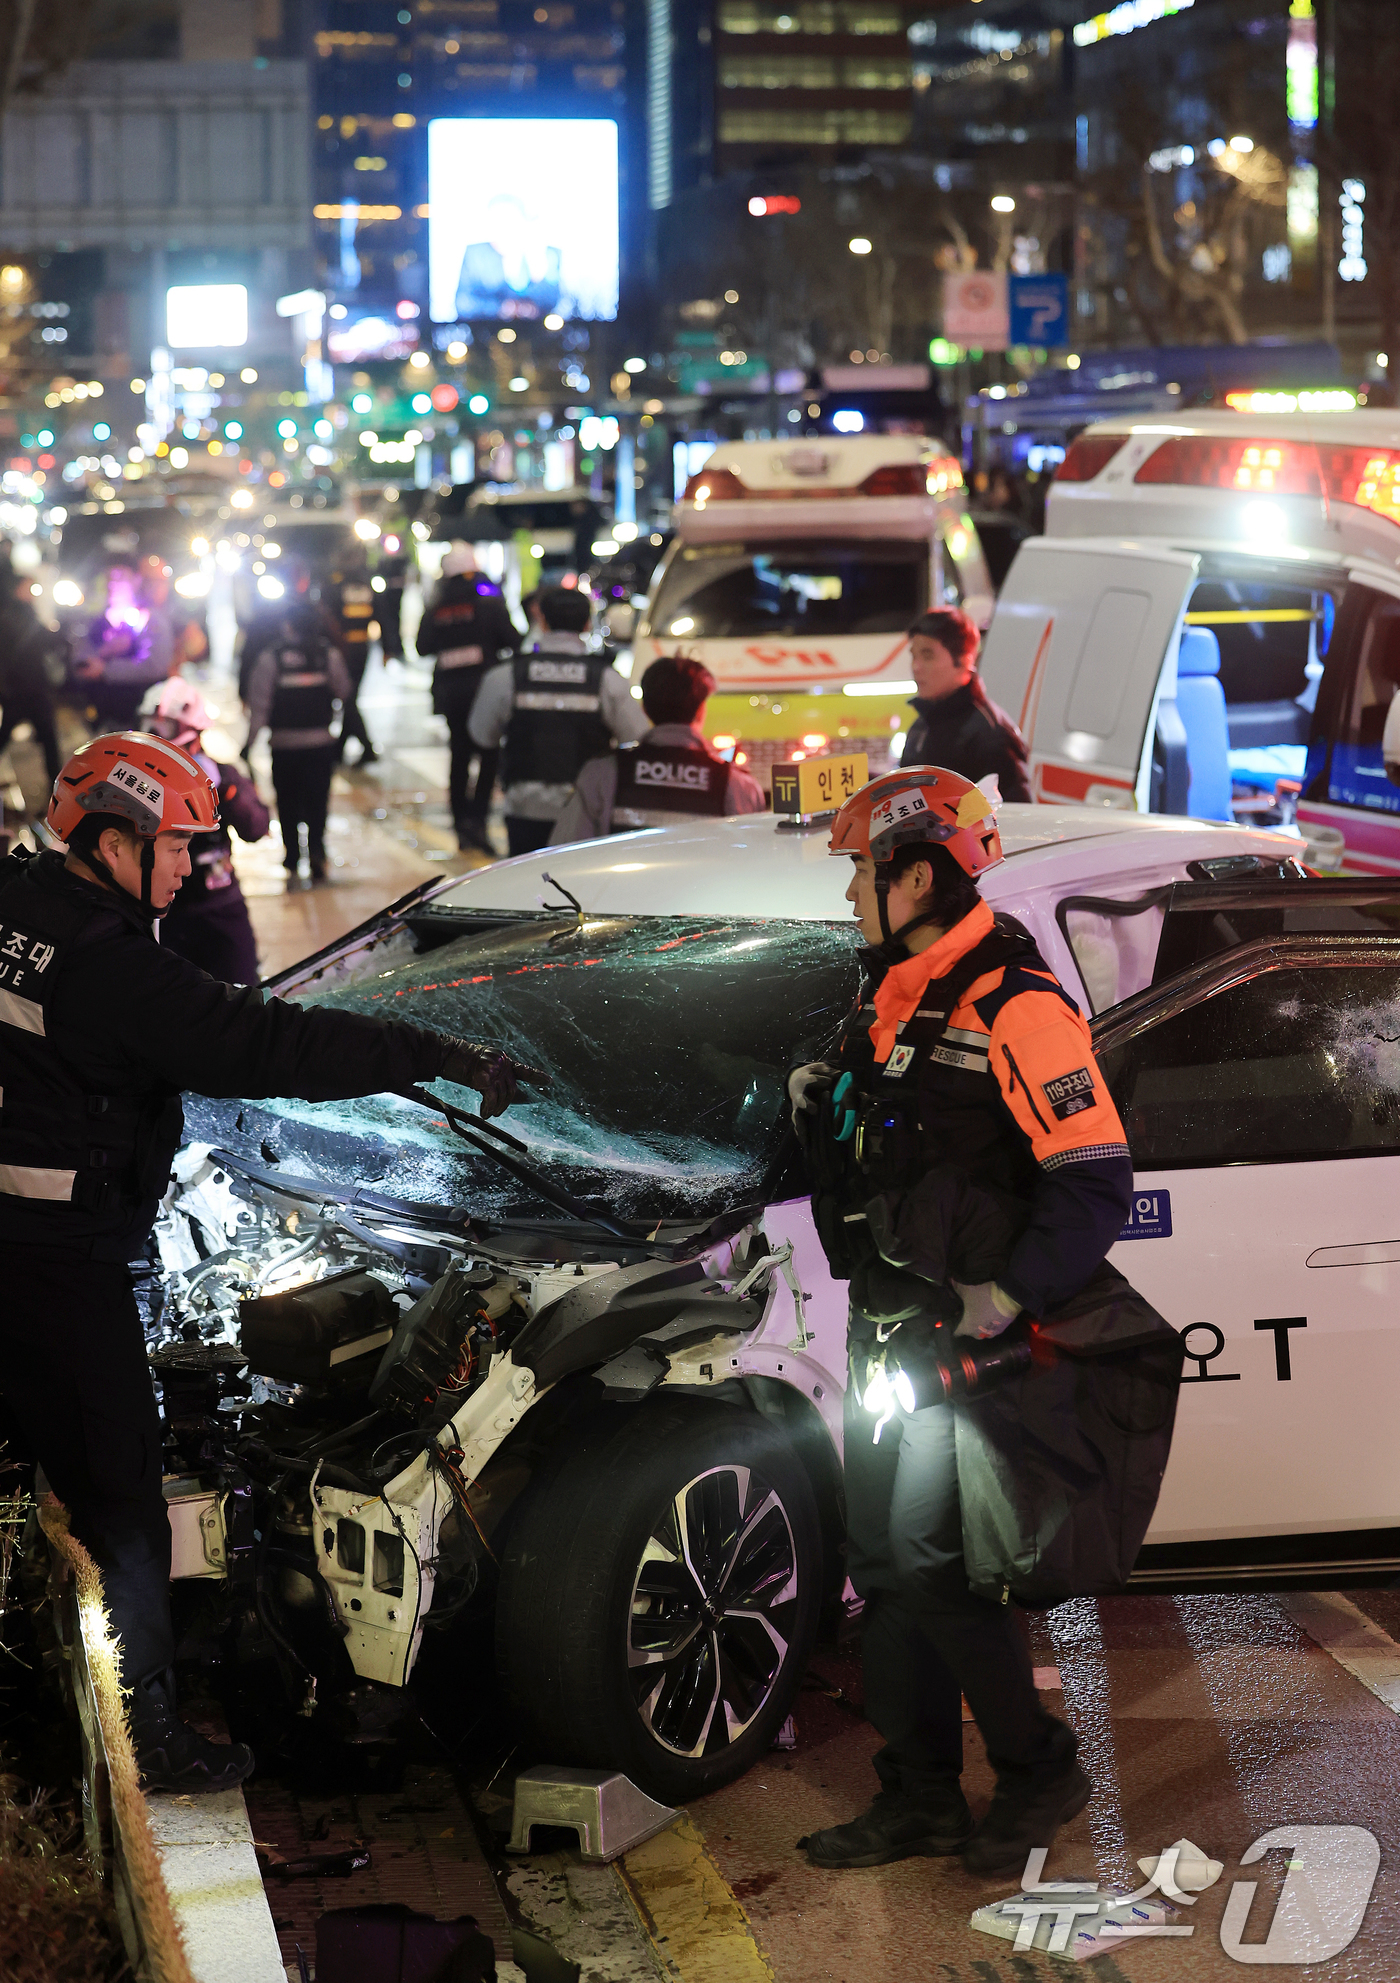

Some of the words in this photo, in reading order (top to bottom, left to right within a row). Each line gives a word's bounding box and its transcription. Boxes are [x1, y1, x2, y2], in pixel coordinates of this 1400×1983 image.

[528, 660, 588, 684] POLICE
[635, 760, 710, 791] POLICE
[818, 764, 854, 802] 인천
[873, 800, 892, 821] 119
[883, 798, 926, 824] 구조대
[0, 924, 55, 974] 조대
[932, 1046, 967, 1066] RESCUE
[1046, 1069, 1093, 1101] 119구조대
